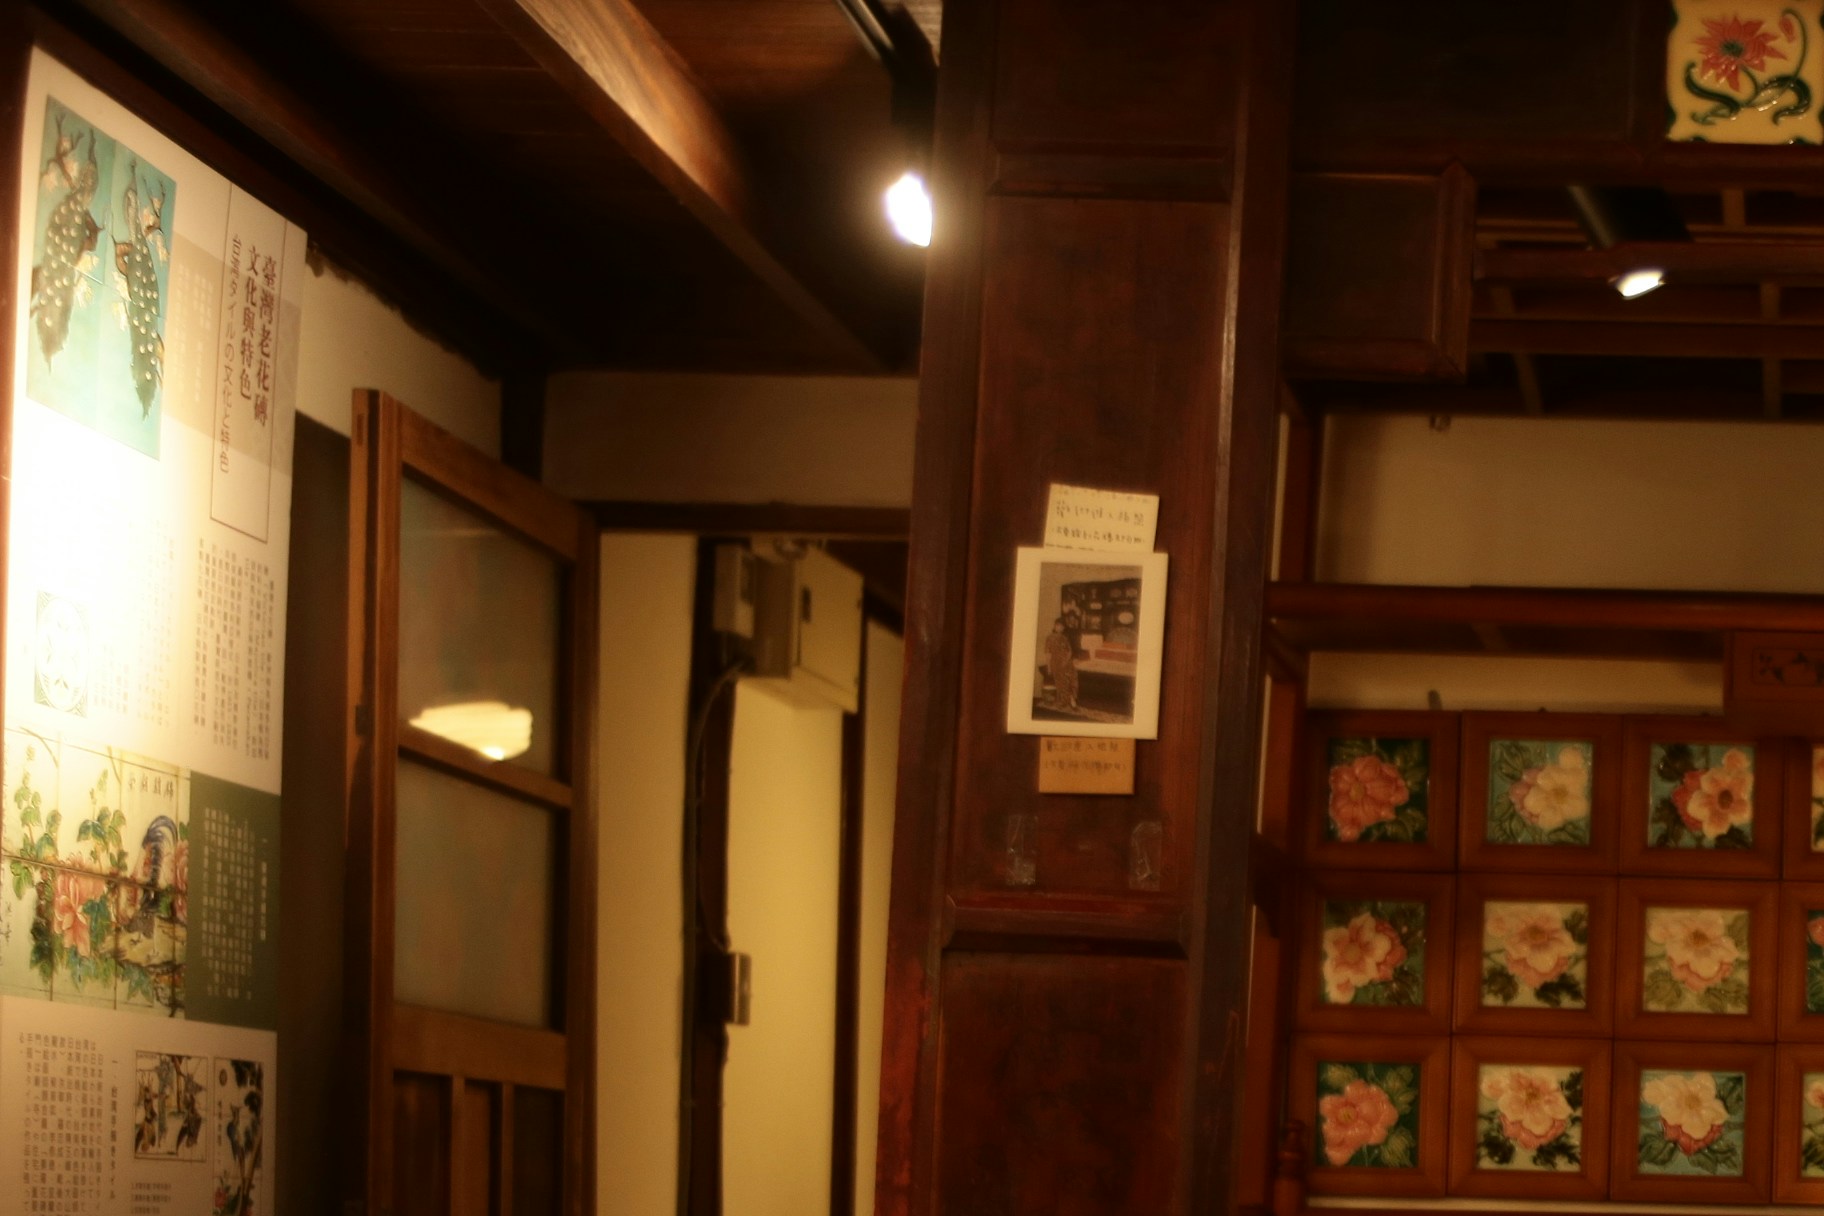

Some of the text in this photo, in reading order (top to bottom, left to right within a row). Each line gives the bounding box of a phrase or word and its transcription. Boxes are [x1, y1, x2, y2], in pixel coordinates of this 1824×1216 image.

[239, 244, 261, 401] 文化與特色
[254, 255, 277, 428] 臺灣老花磚
